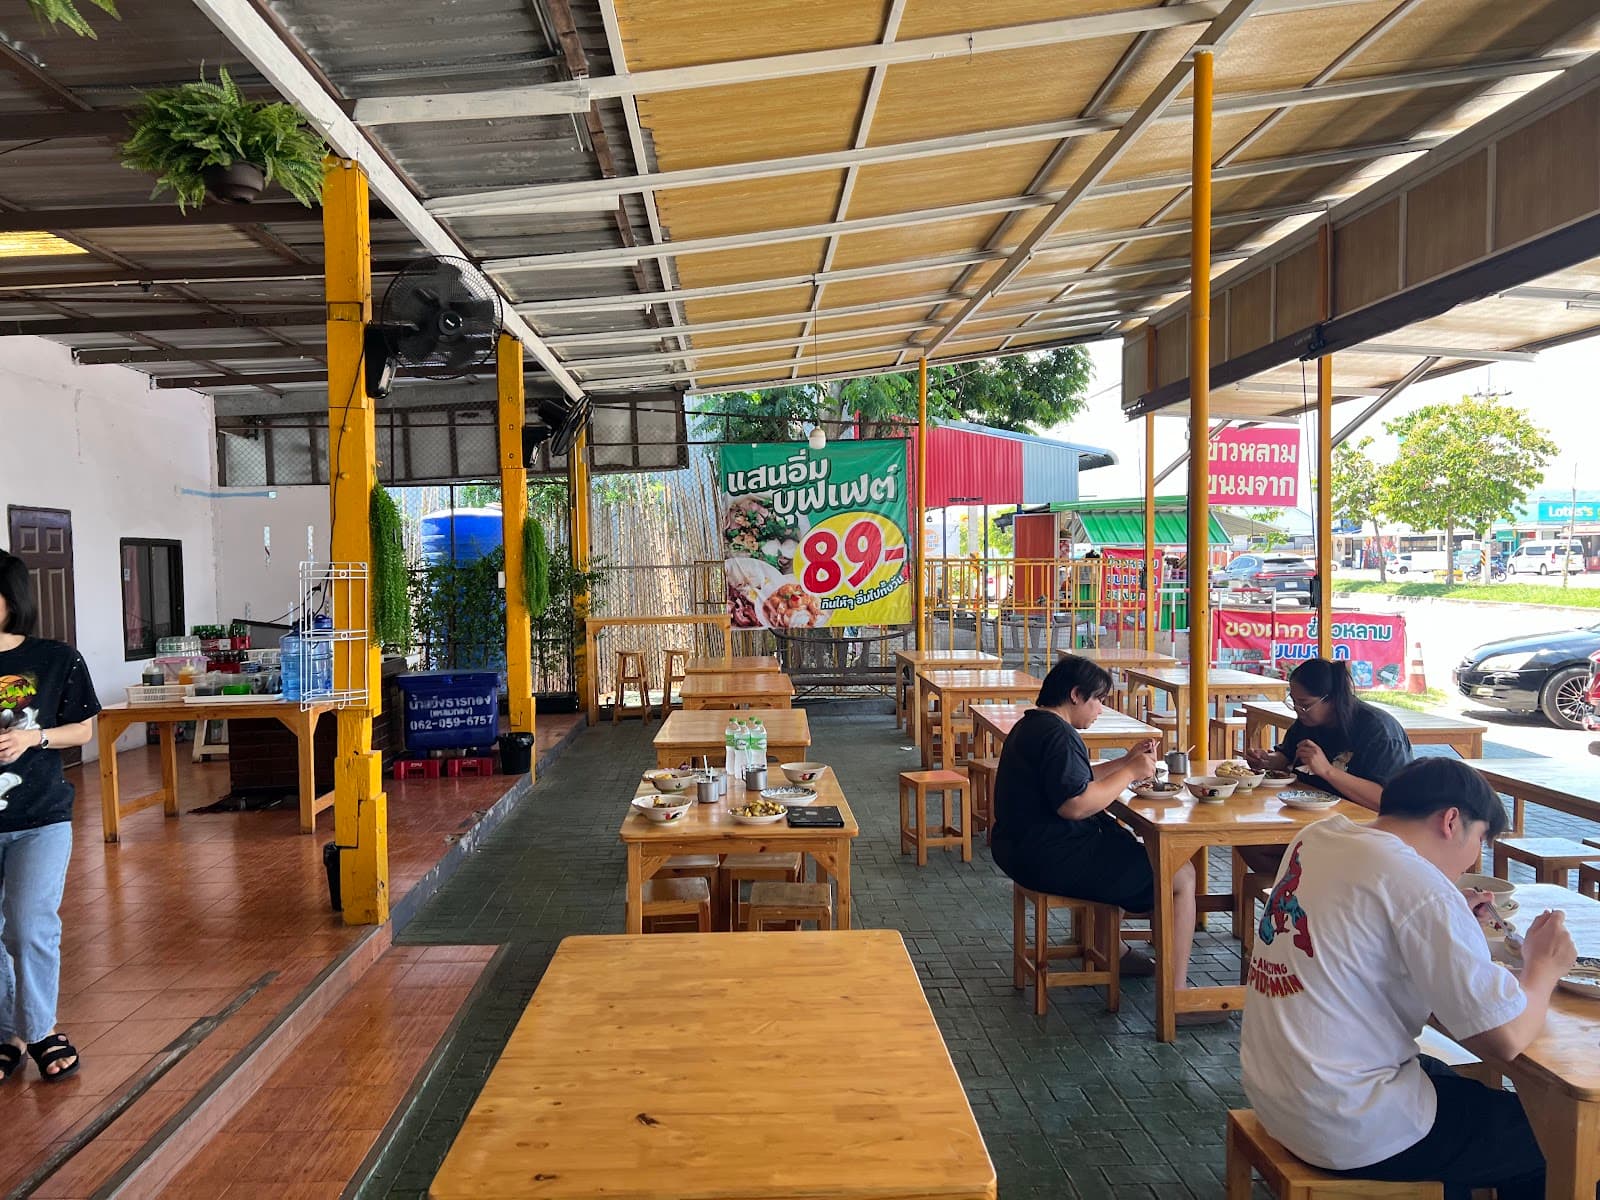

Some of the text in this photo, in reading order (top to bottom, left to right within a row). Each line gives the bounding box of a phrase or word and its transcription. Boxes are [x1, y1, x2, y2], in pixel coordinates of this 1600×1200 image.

[727, 450, 828, 493] แสนอิ่ม
[773, 464, 901, 525] บุฟเฟต์
[410, 715, 494, 730] 062-059-6757
